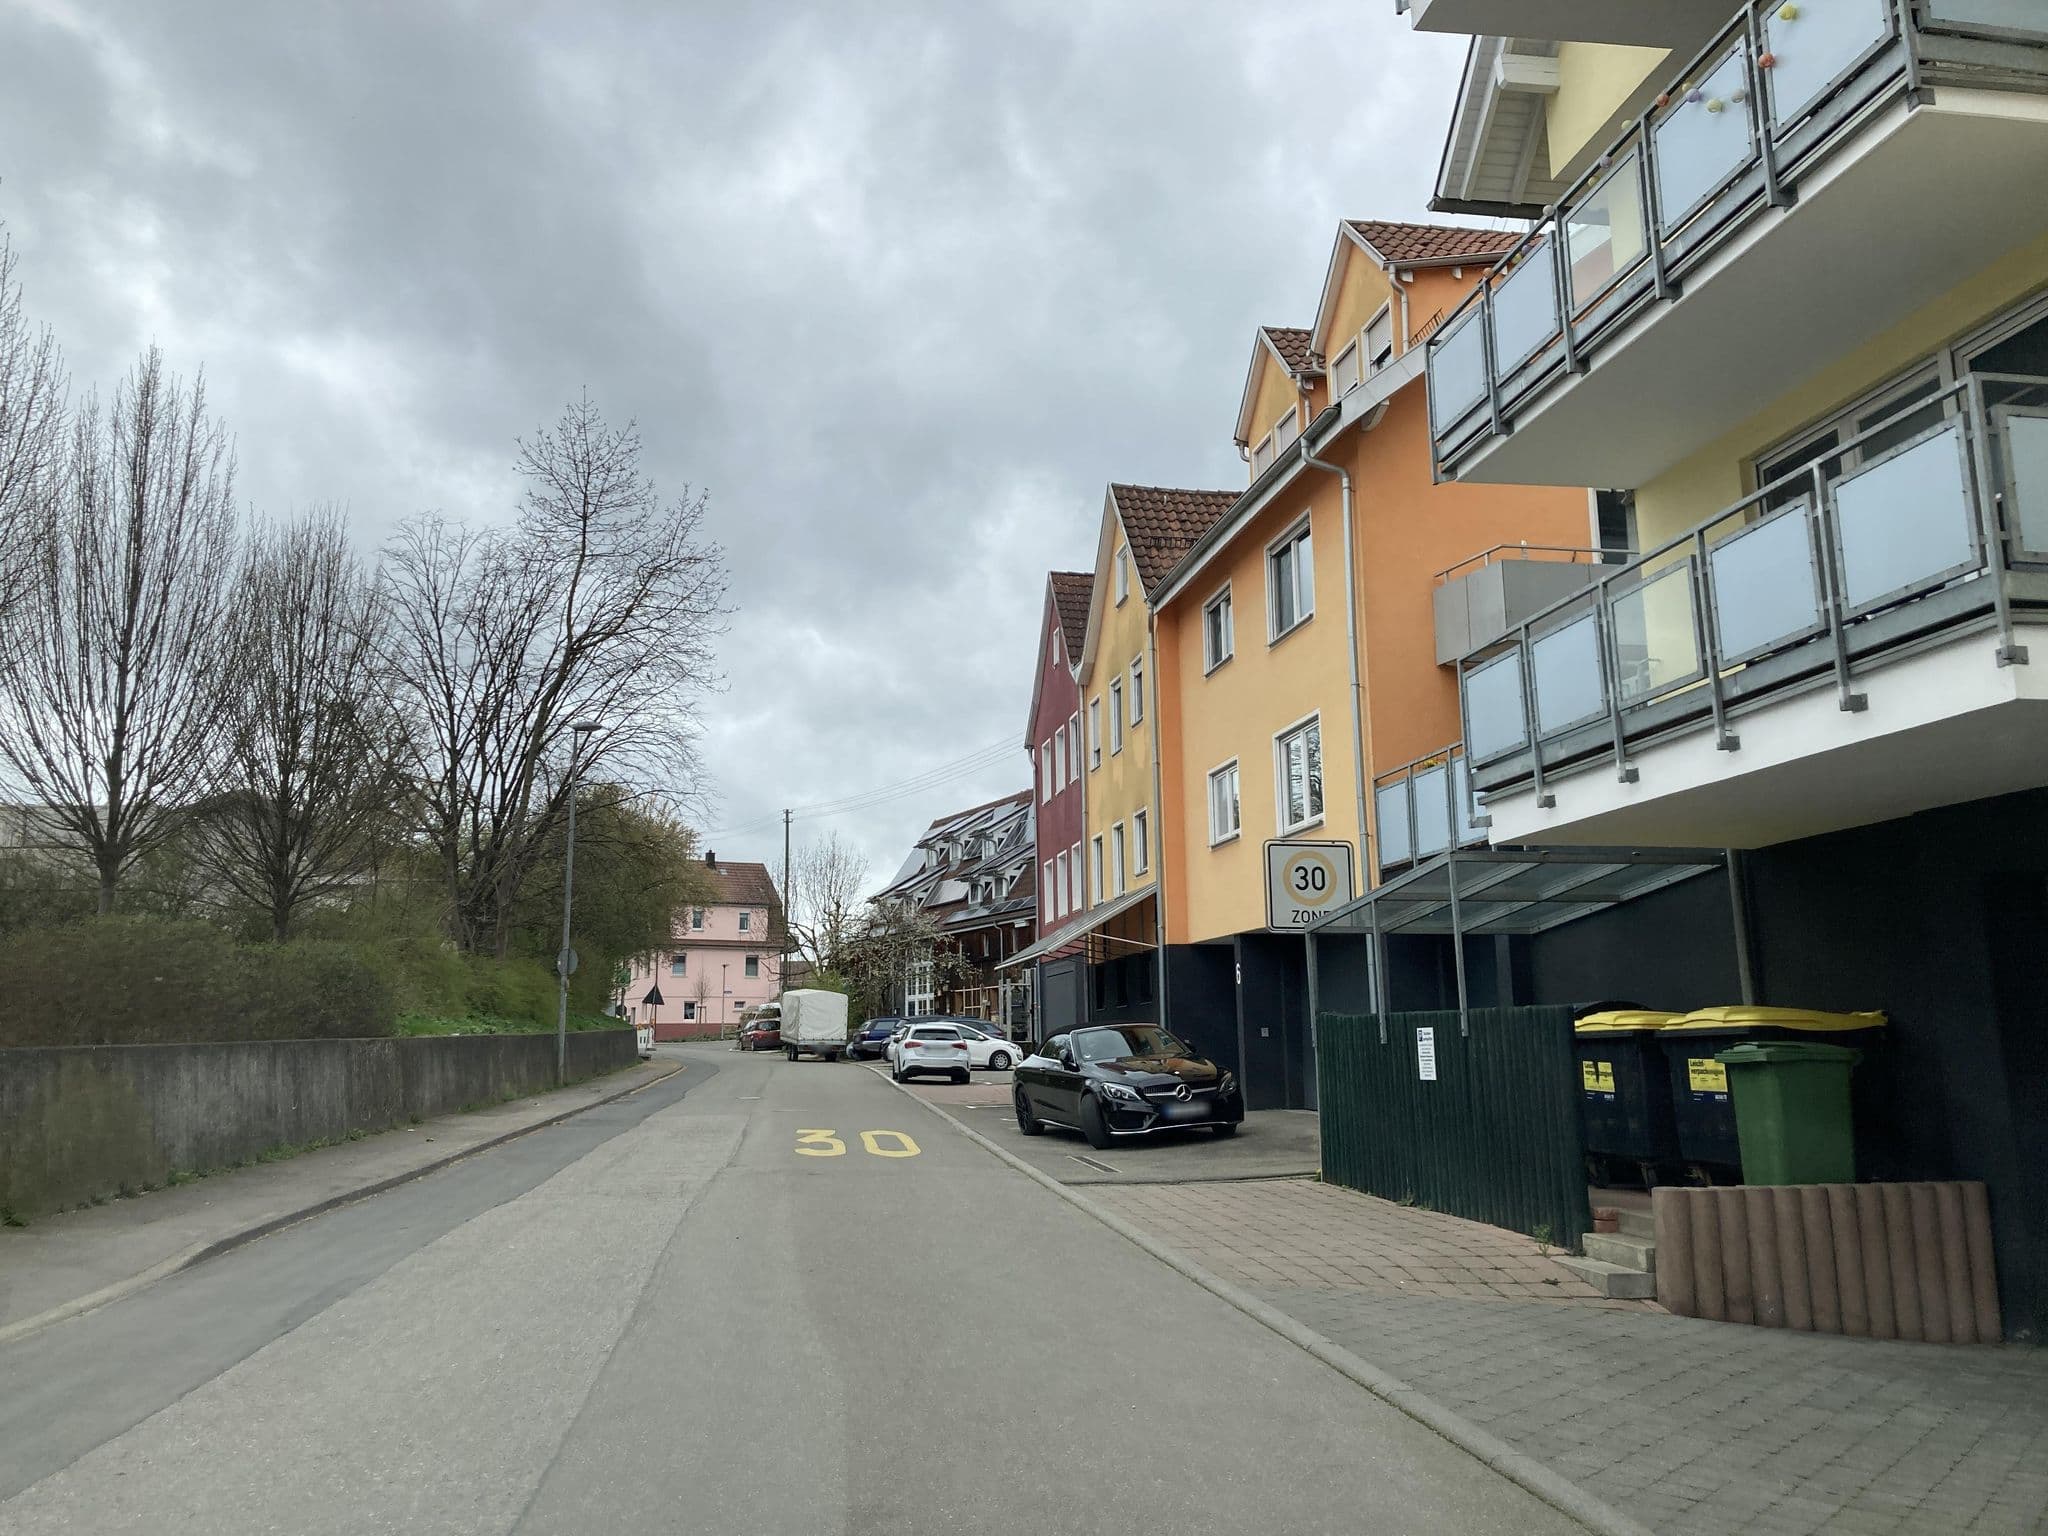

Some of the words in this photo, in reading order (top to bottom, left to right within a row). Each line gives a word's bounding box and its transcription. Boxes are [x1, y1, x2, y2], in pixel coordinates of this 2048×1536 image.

[1294, 866, 1326, 891] 30
[1291, 910, 1331, 923] ZON
[1235, 962, 1242, 985] 6
[794, 1128, 922, 1157] 30
